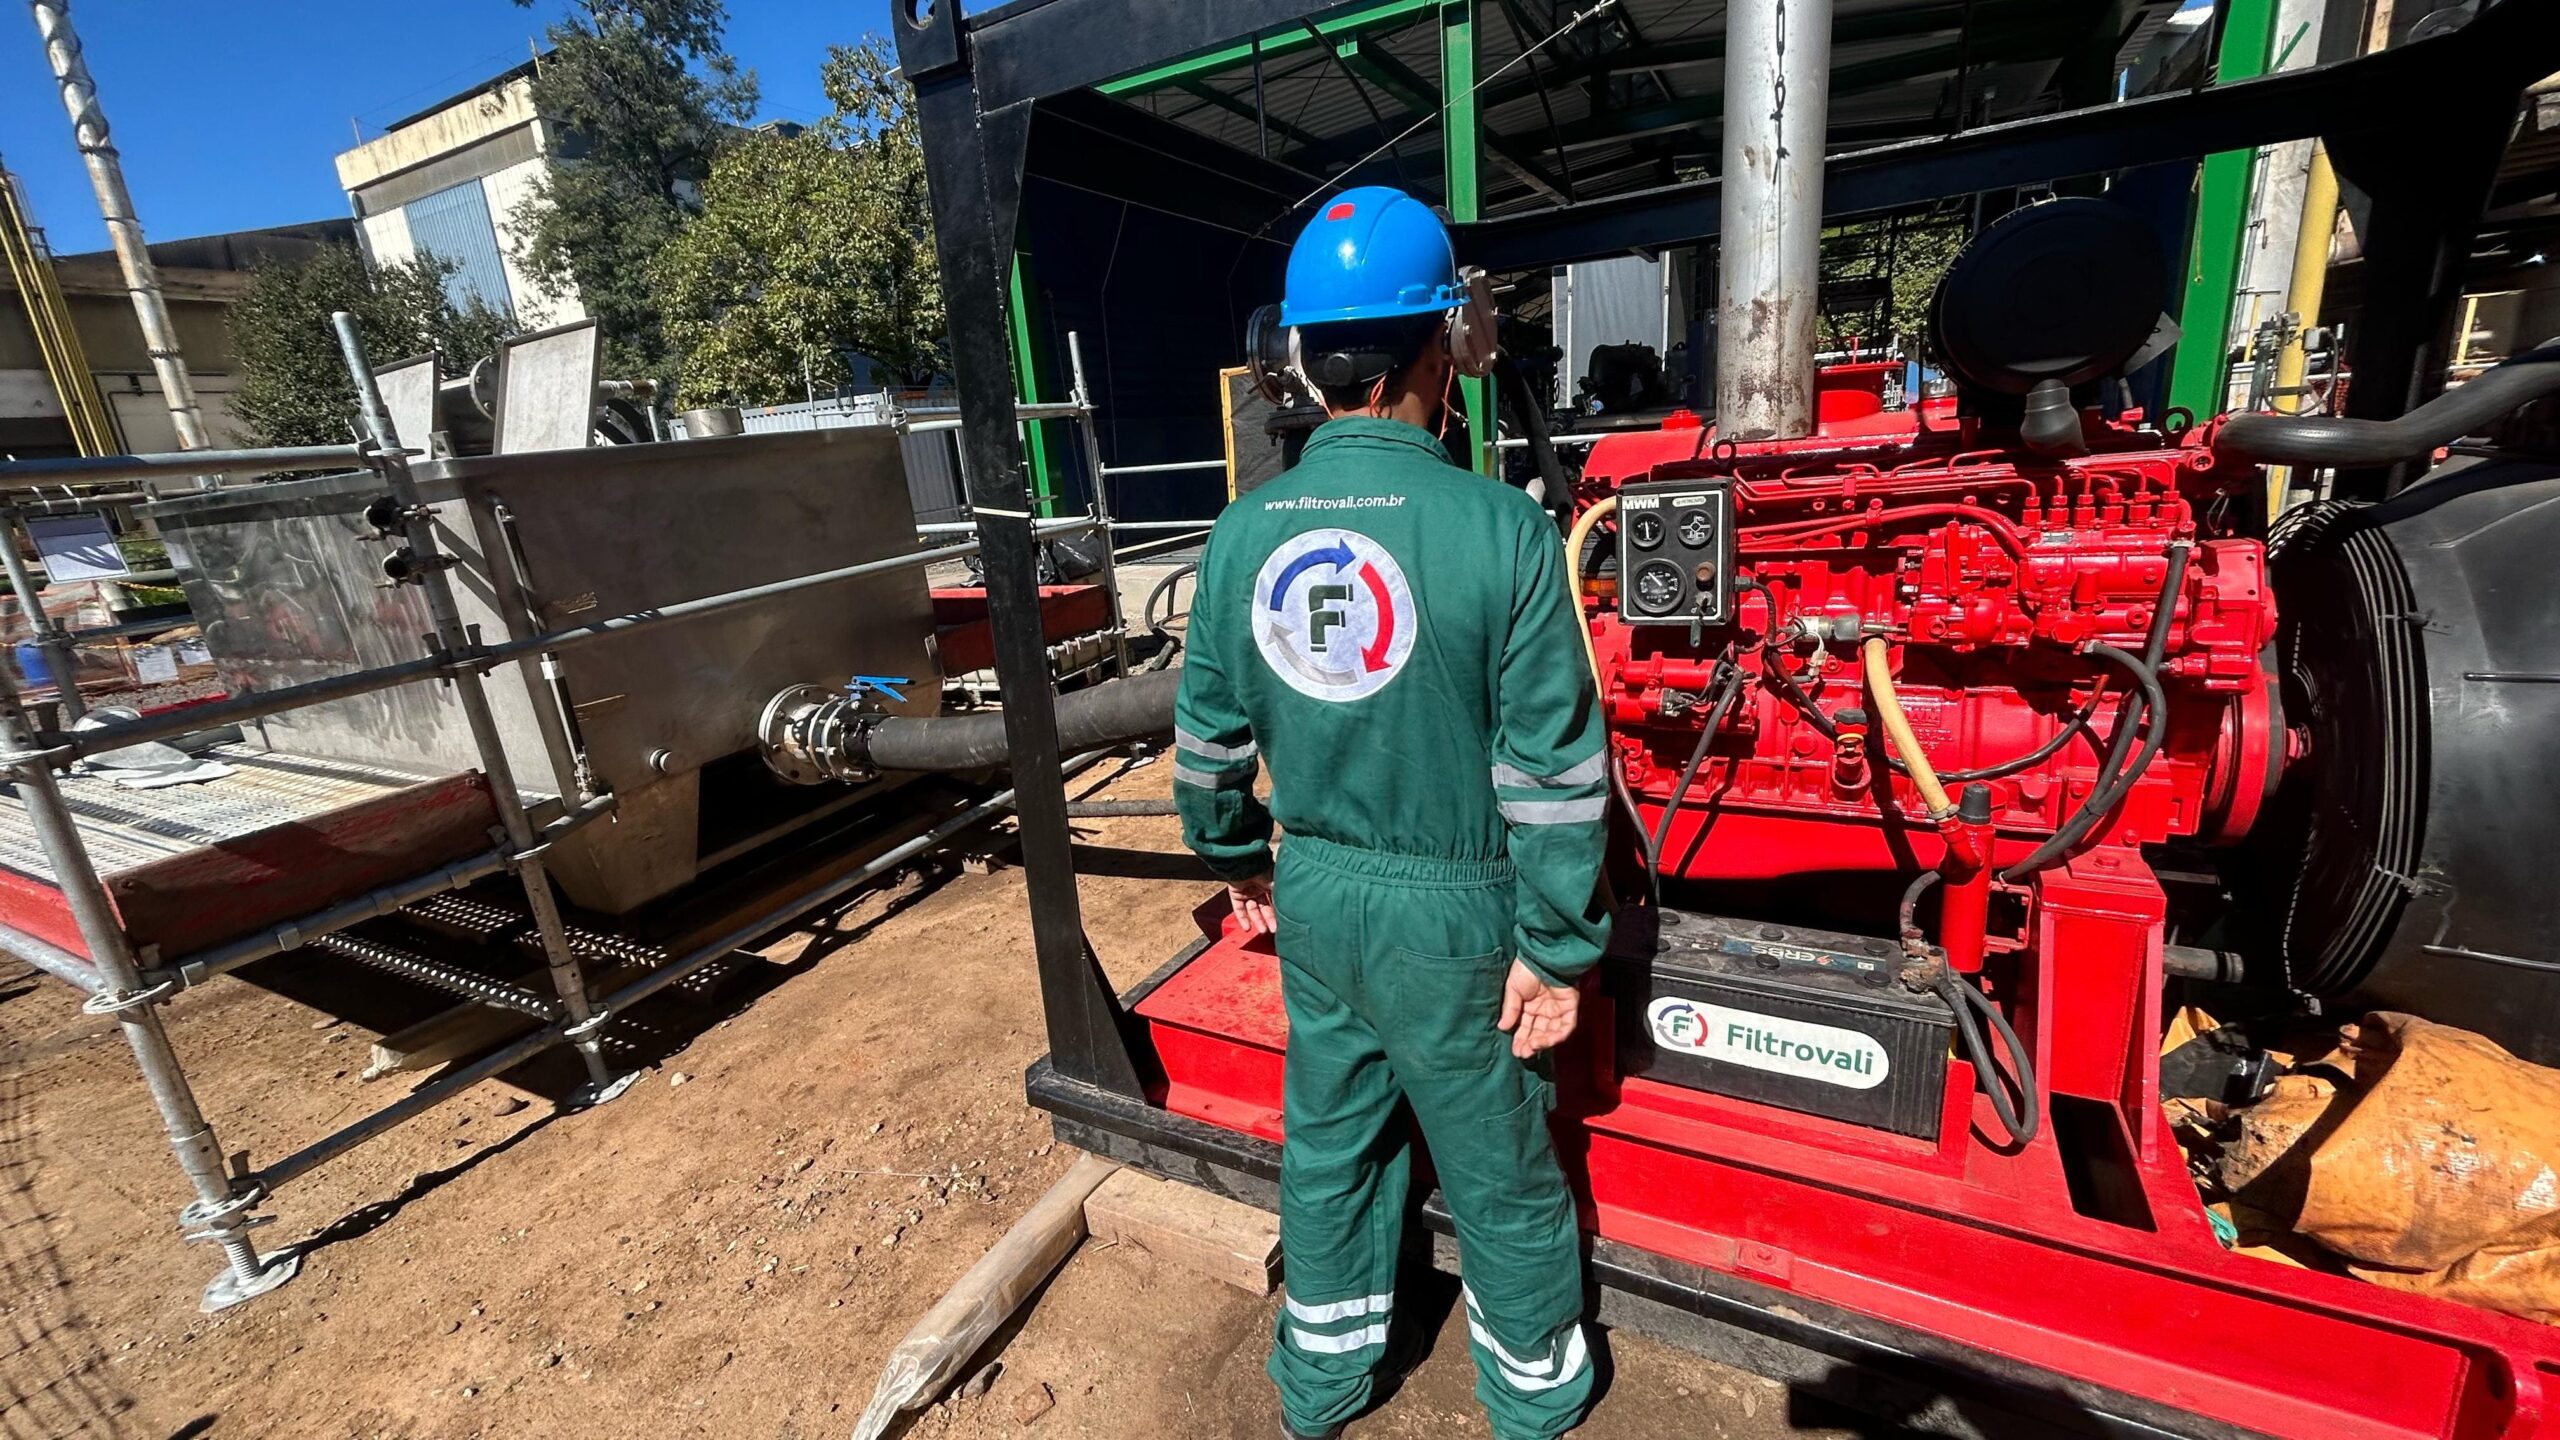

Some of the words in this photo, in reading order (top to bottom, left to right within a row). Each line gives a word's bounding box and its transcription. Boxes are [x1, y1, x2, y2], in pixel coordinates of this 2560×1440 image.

[1264, 494, 1406, 511] www.filtrovali.com.br
[1622, 497, 1660, 510] MWM
[1727, 1023, 1874, 1075] Filtrovali
